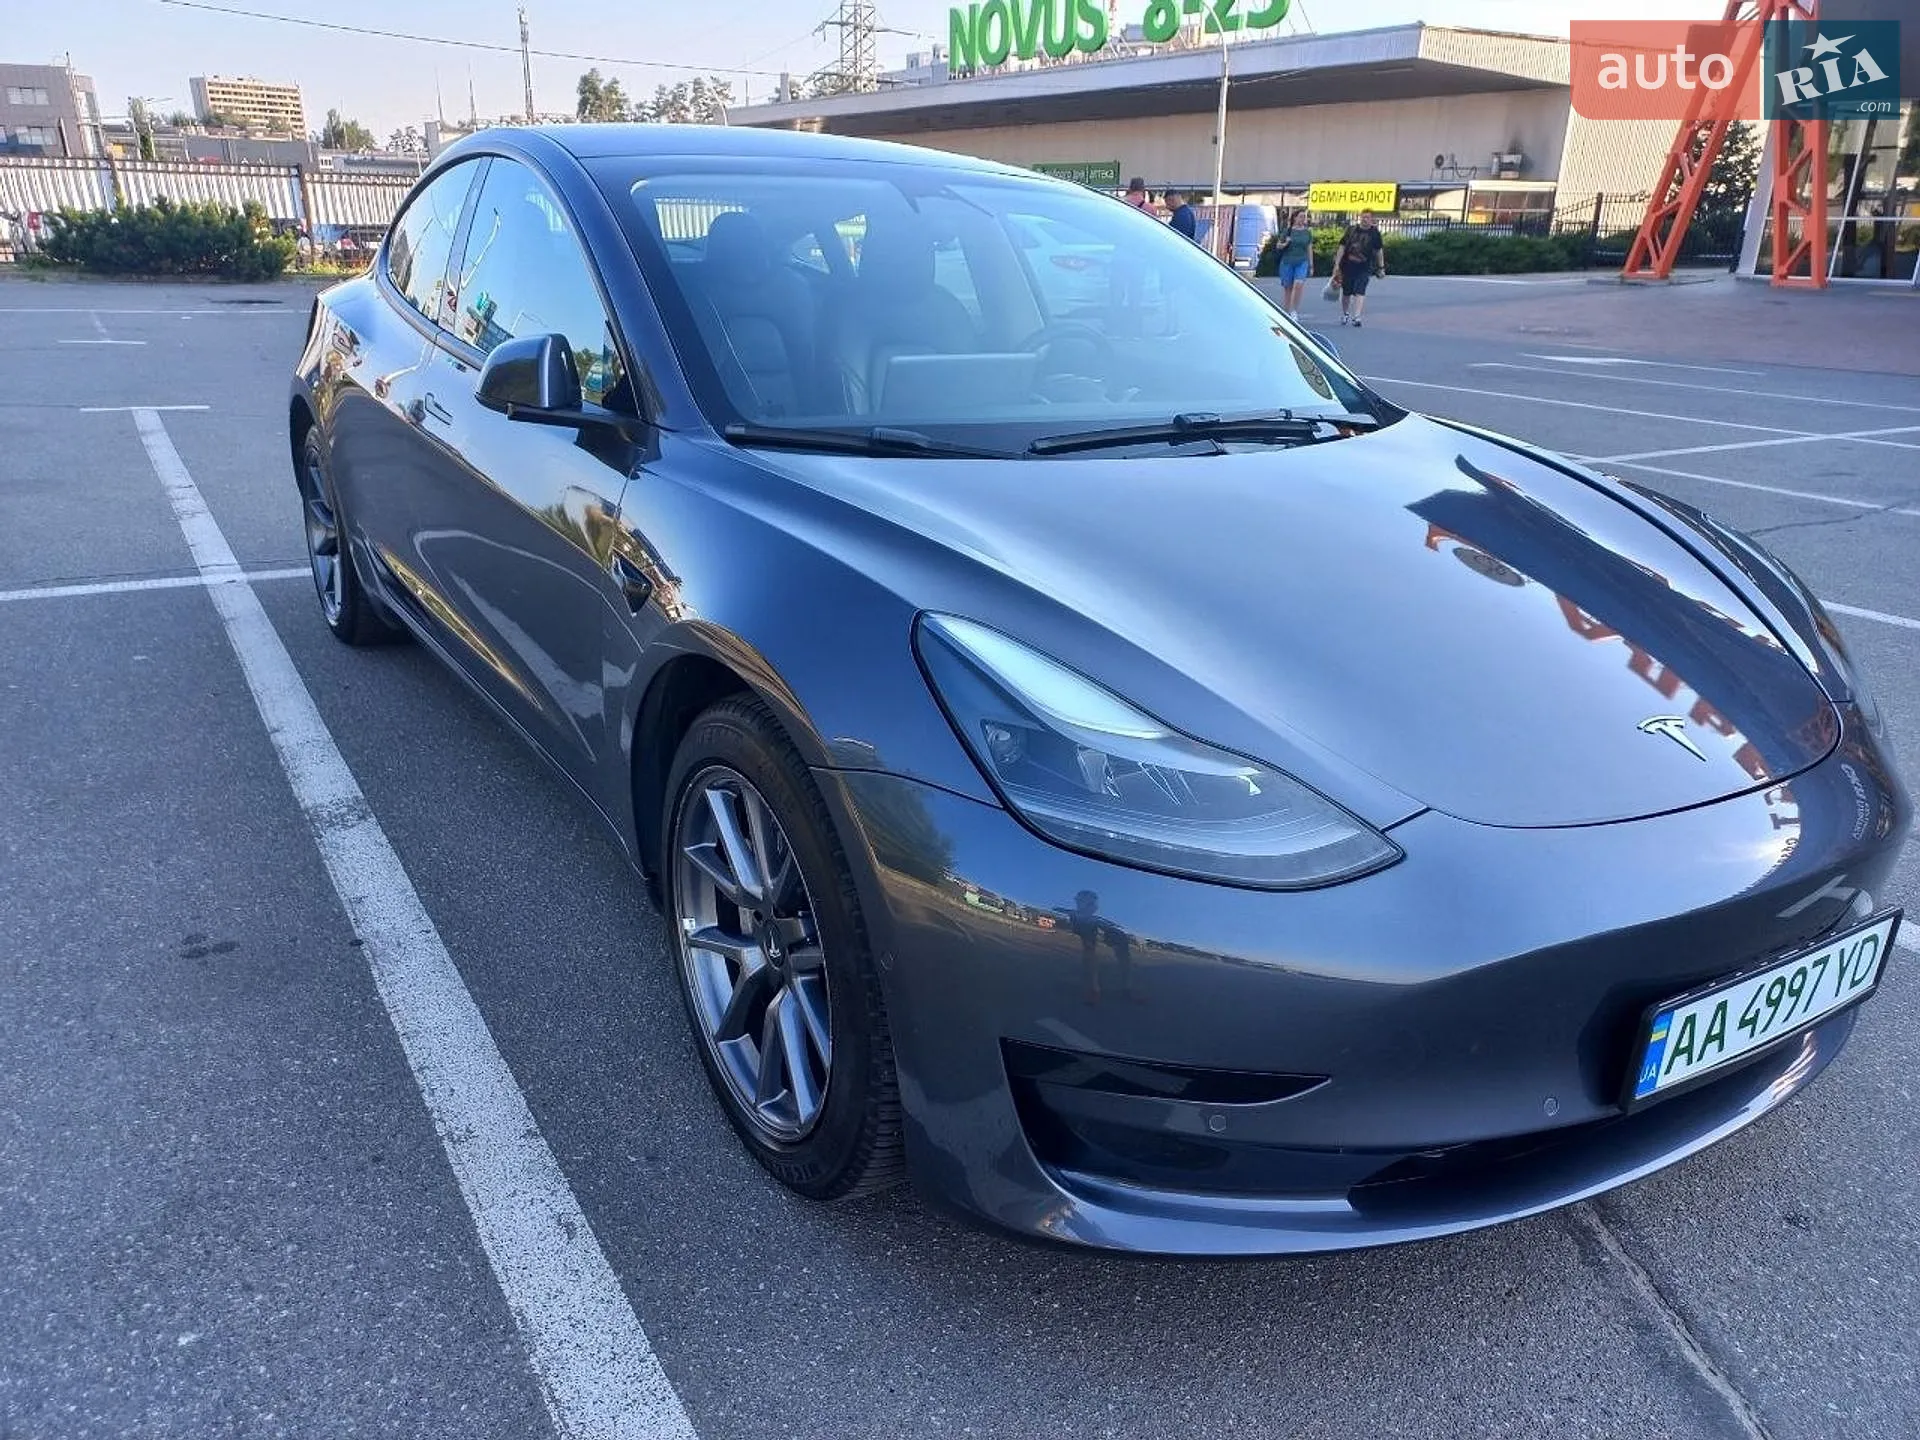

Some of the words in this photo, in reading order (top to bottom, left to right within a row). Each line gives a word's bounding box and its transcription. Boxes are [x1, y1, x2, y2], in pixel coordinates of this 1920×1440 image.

[949, 0, 1108, 72] NOVUS
[1311, 190, 1347, 203] ОБМІН
[1350, 190, 1393, 203] ВАЛЮТ
[1664, 999, 1728, 1075] AA
[1737, 954, 1831, 1038] 4997
[1835, 933, 1880, 998] YD
